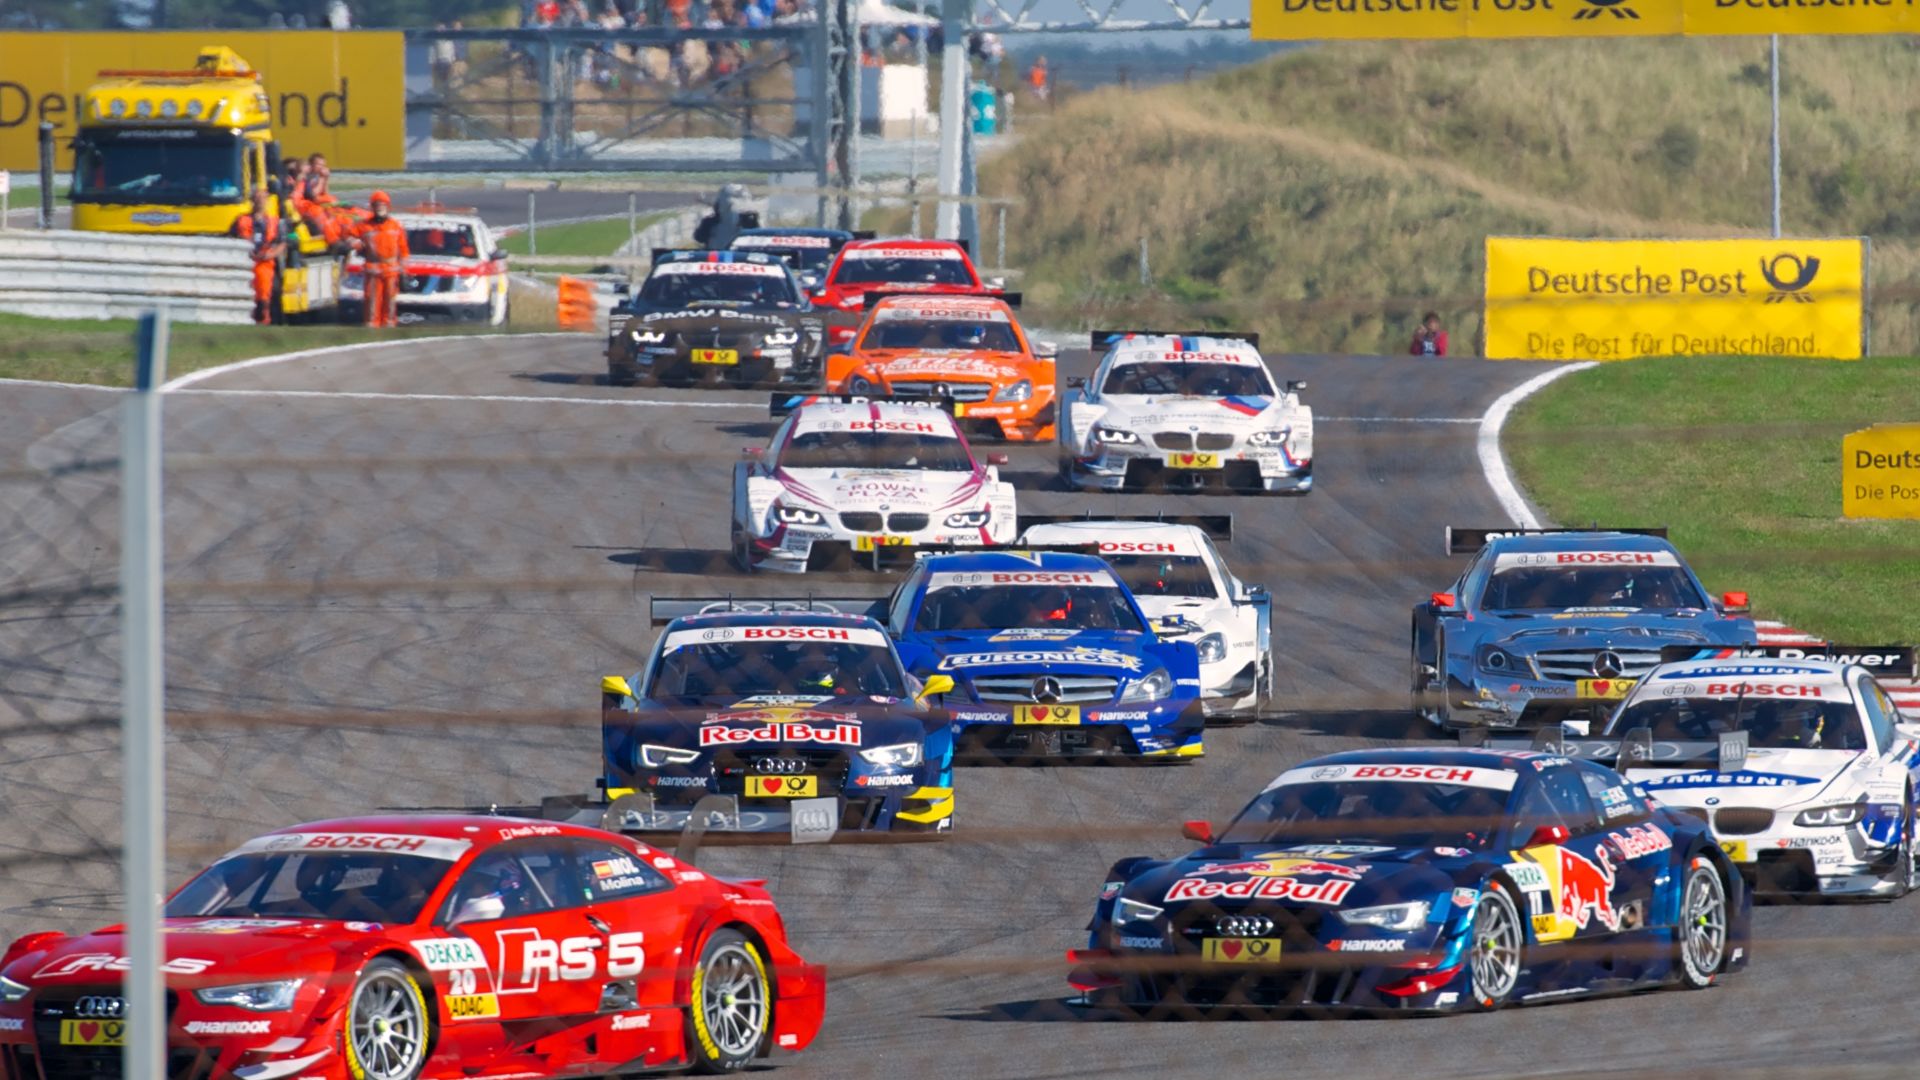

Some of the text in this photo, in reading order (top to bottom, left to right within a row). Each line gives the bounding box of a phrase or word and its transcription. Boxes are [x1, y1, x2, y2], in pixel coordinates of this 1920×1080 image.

[882, 249, 944, 257] BOSCH
[699, 262, 766, 273] BOSCH
[1527, 266, 1747, 294] Deutsche Post
[644, 308, 785, 326] BMW Bank
[920, 309, 991, 319] BOSCH
[1527, 332, 1821, 355] Die Post für Deutschland.
[1164, 352, 1240, 362] BOSCH
[850, 421, 934, 432] BOSCH
[836, 482, 929, 493] CROWNE
[848, 490, 918, 499] PLAZA
[1855, 484, 1884, 500] Die
[1091, 542, 1175, 552] OSCH
[1556, 553, 1655, 564] BOSCH
[992, 572, 1094, 584] BOSCH
[744, 628, 849, 640] BOSCH
[951, 652, 1115, 666] EURONICS
[1779, 648, 1900, 667] Power
[1679, 665, 1814, 676] SAMSUNG
[1706, 683, 1822, 697] BOSCH
[701, 723, 860, 745] Red Bull
[1353, 767, 1473, 782] BOSCH
[1648, 774, 1798, 786] SAMSUNG
[304, 835, 426, 850] BOSCH
[610, 857, 640, 875] MOL
[600, 875, 645, 891] Molina
[1167, 877, 1353, 904] Red Bull
[424, 942, 477, 964] DEKRA
[449, 969, 477, 996] 20
[452, 996, 484, 1016] ADAC
